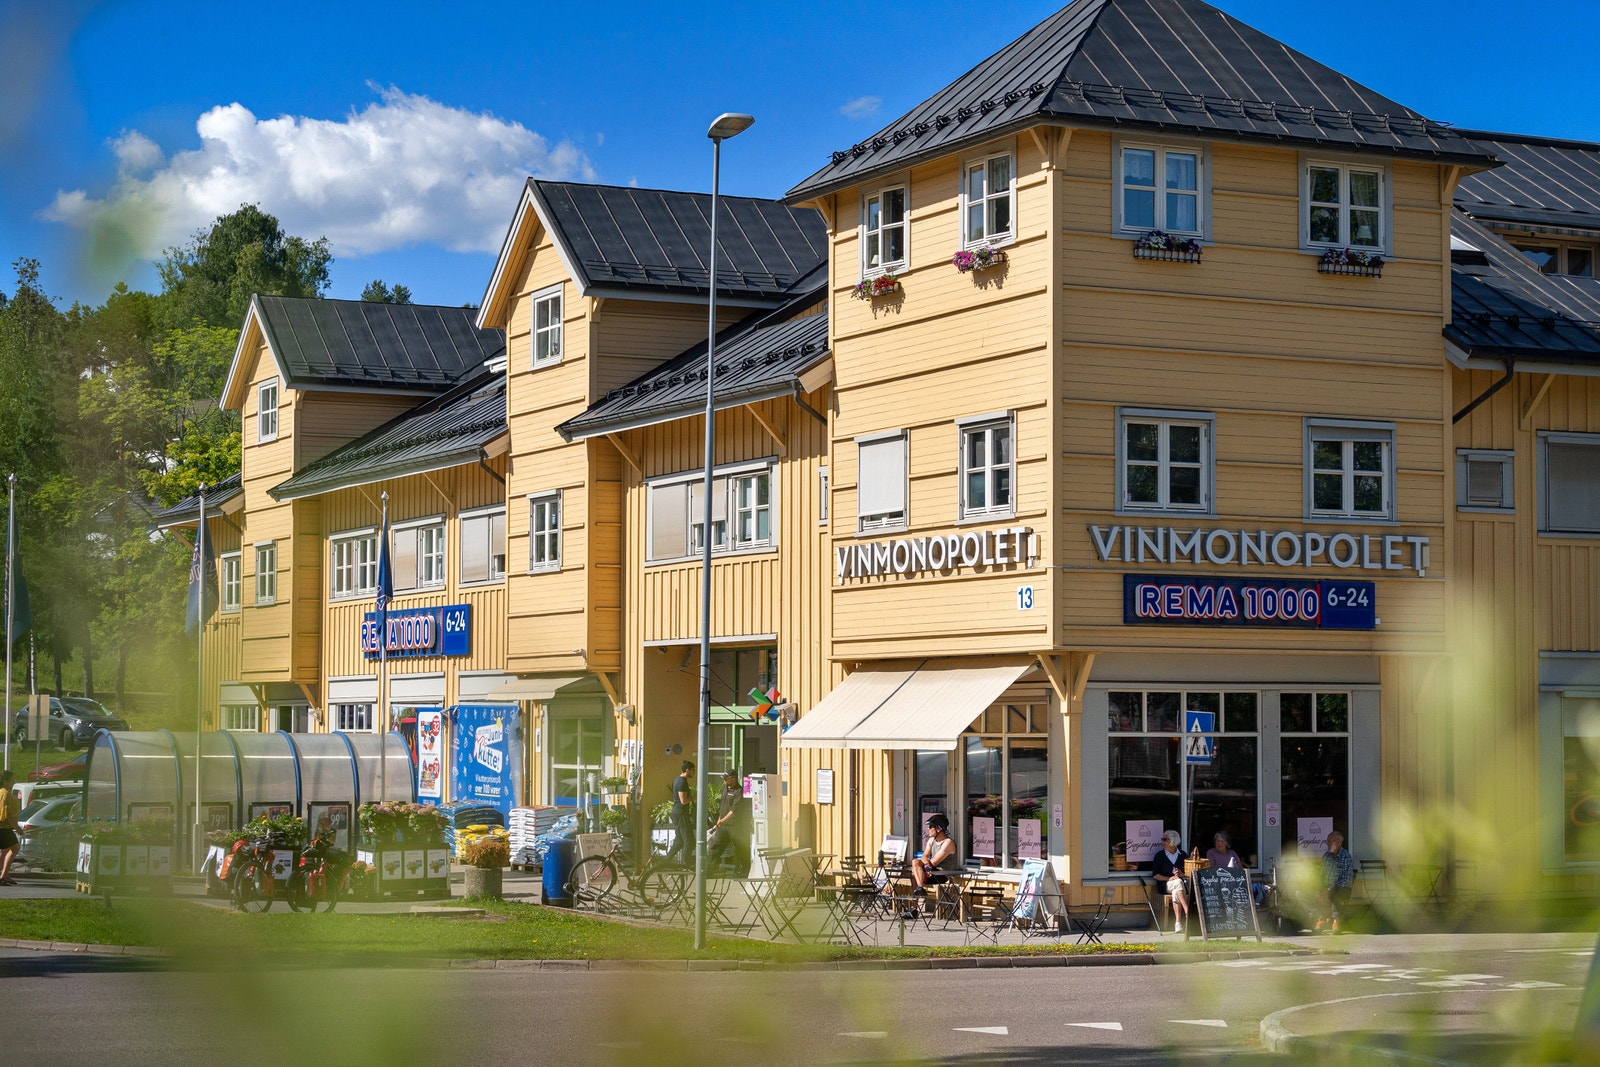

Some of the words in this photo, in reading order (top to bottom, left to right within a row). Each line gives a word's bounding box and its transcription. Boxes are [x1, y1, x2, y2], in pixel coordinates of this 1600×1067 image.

[836, 526, 1031, 578] VINMONOPOLET
[1089, 525, 1430, 570] VINMONOPOLET
[1018, 587, 1033, 609] 13
[1135, 582, 1239, 619] REMA
[1241, 586, 1320, 620] 1000
[1327, 587, 1369, 607] 6-24
[361, 618, 398, 652] REA
[399, 614, 433, 650] 1000
[446, 610, 466, 632] 6-24
